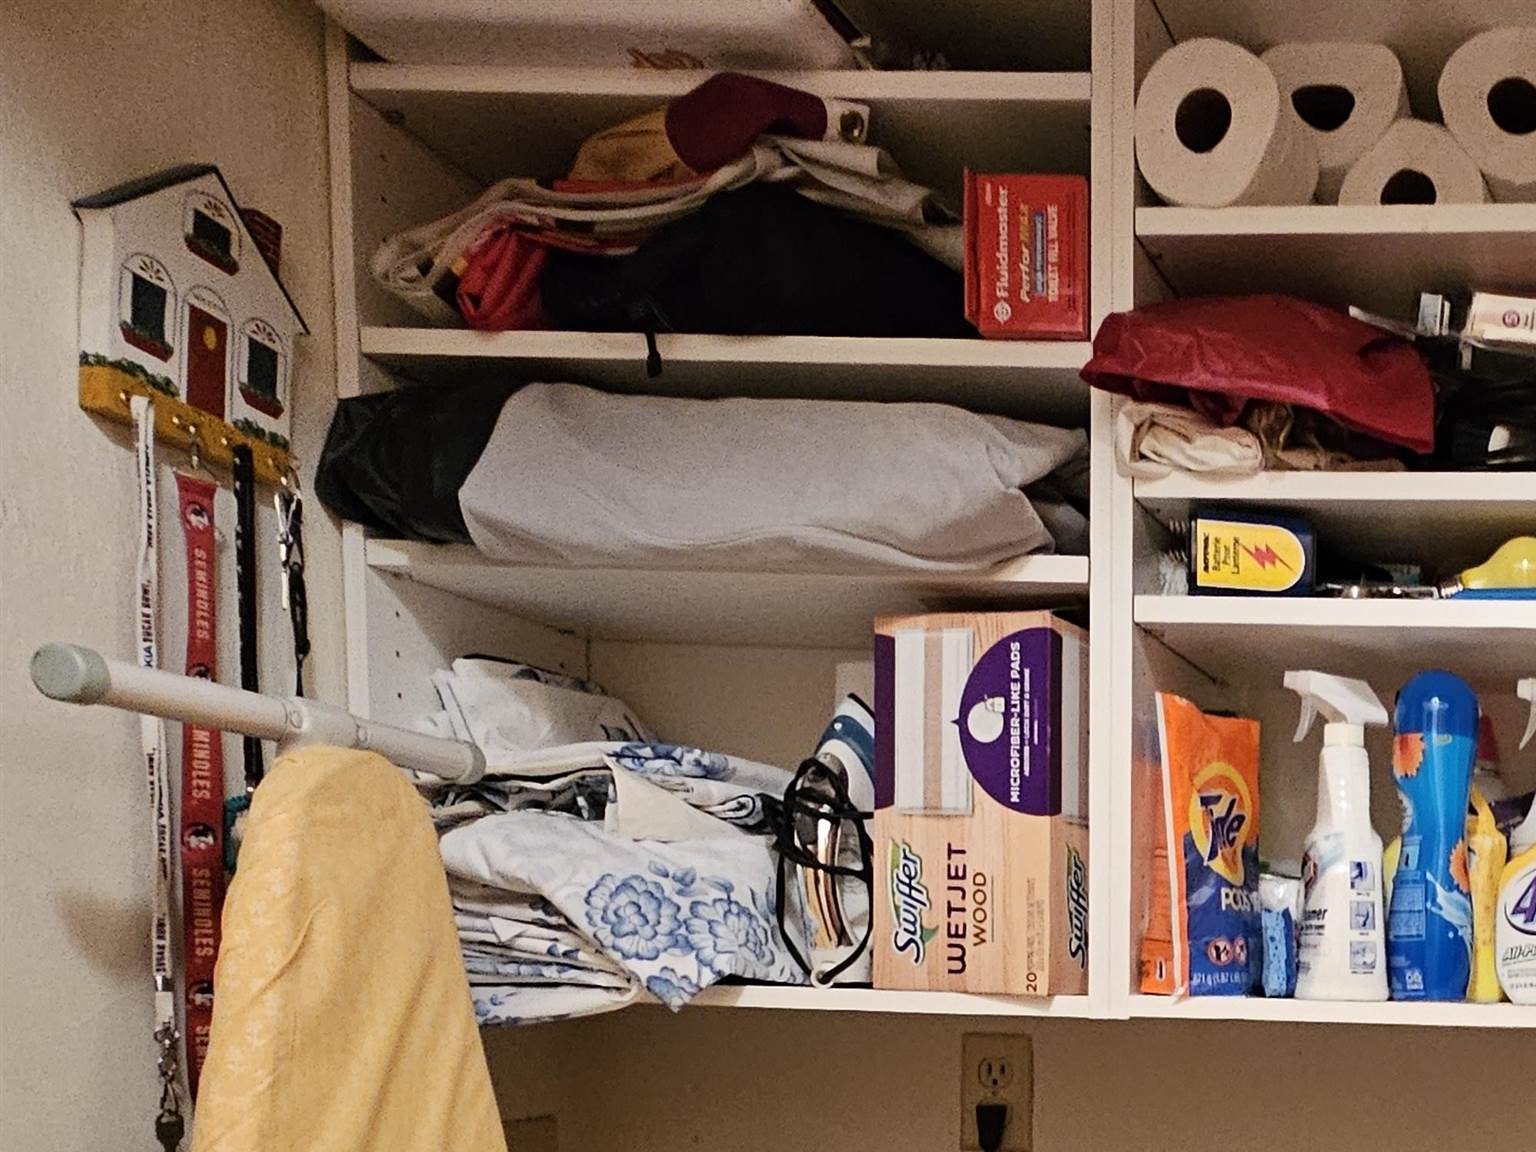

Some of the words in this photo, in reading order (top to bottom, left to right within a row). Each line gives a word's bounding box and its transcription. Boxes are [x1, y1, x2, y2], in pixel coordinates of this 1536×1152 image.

[996, 185, 1009, 298] Fluidmaster
[1047, 204, 1058, 238] VALVE
[1048, 241, 1058, 262] FILL
[1048, 264, 1058, 302] TOILET
[194, 547, 211, 641] SEMINOLES
[143, 645, 153, 668] KIA
[1010, 642, 1021, 679] PADS
[191, 727, 211, 800] MINOLES
[1010, 682, 1021, 803] MICROFIBER-LIKE
[1199, 794, 1247, 862] Tide
[192, 867, 214, 958] SEMINOLES
[894, 842, 930, 965] Swiffer
[946, 842, 967, 975] WETJET
[972, 872, 987, 947] WOOD
[1026, 972, 1038, 993] 20
